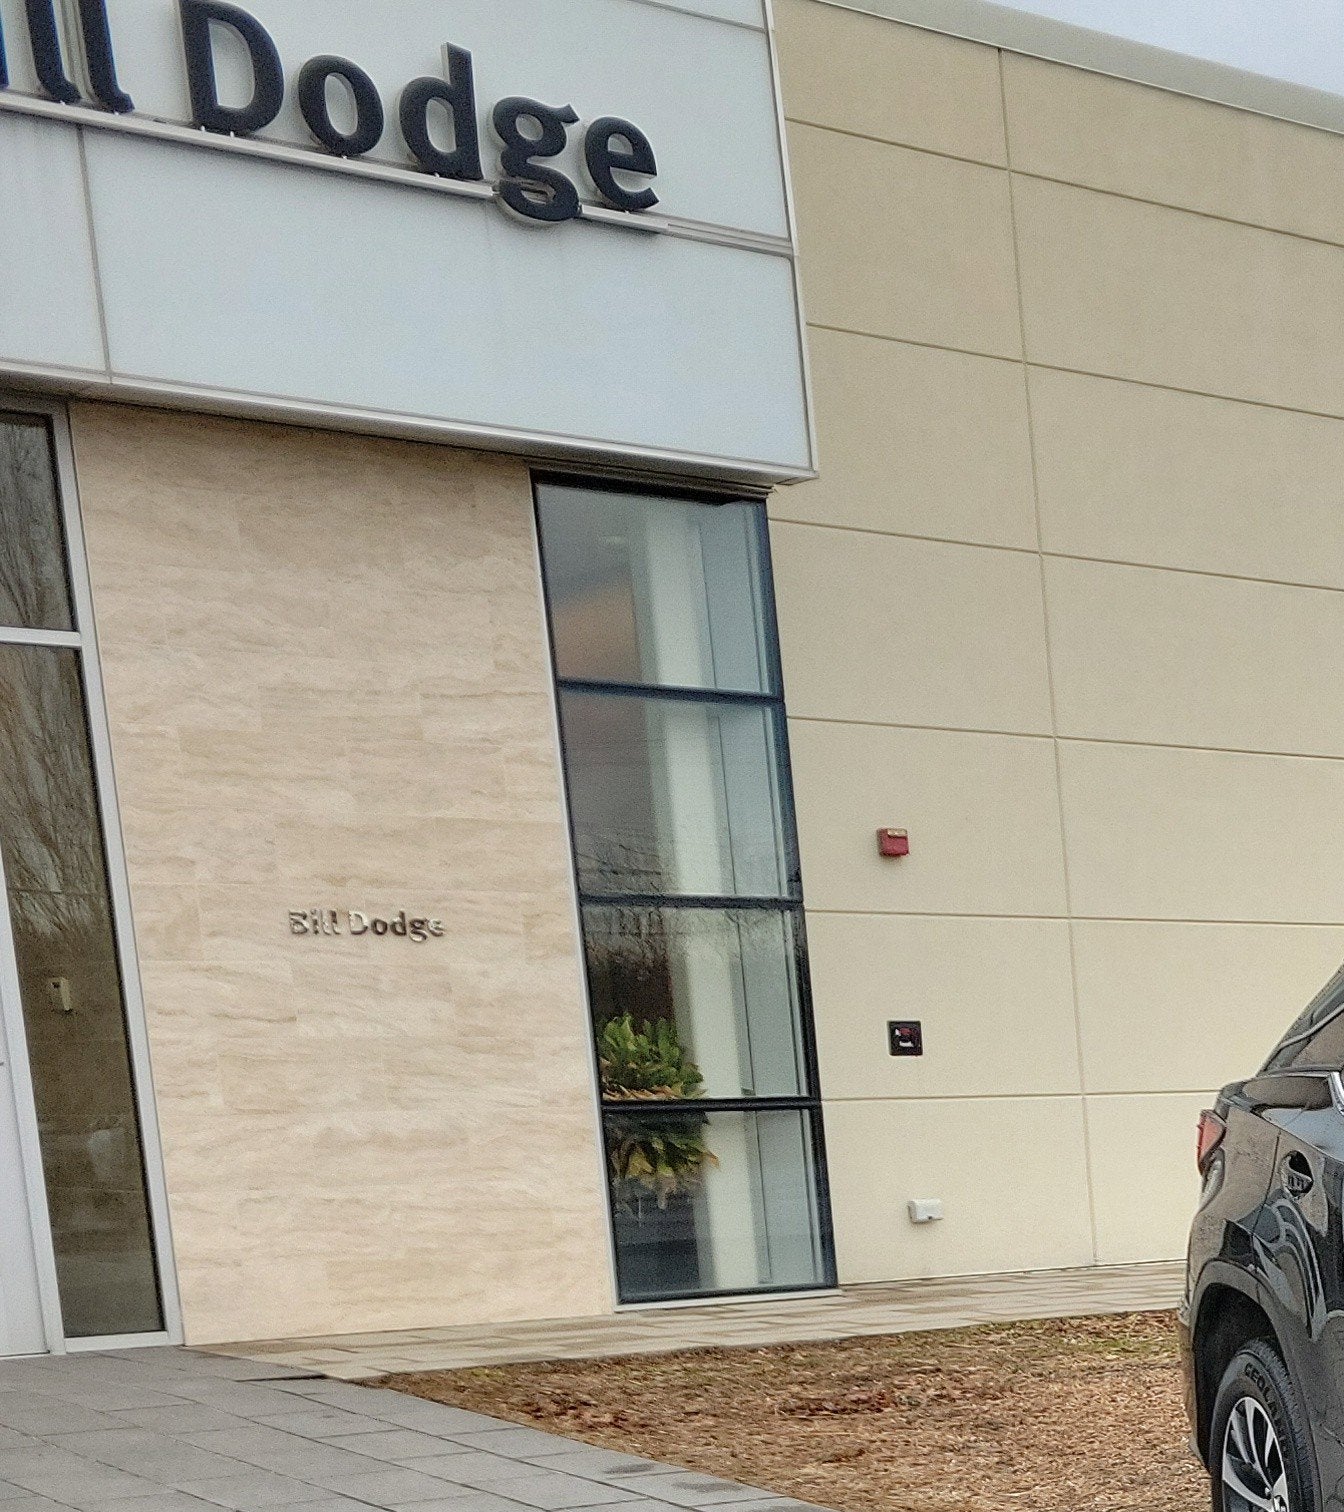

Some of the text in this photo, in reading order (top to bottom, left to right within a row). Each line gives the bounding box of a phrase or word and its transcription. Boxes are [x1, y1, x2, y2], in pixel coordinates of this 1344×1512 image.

[182, 0, 660, 222] Dodge
[289, 907, 445, 943] Bill Dodge
